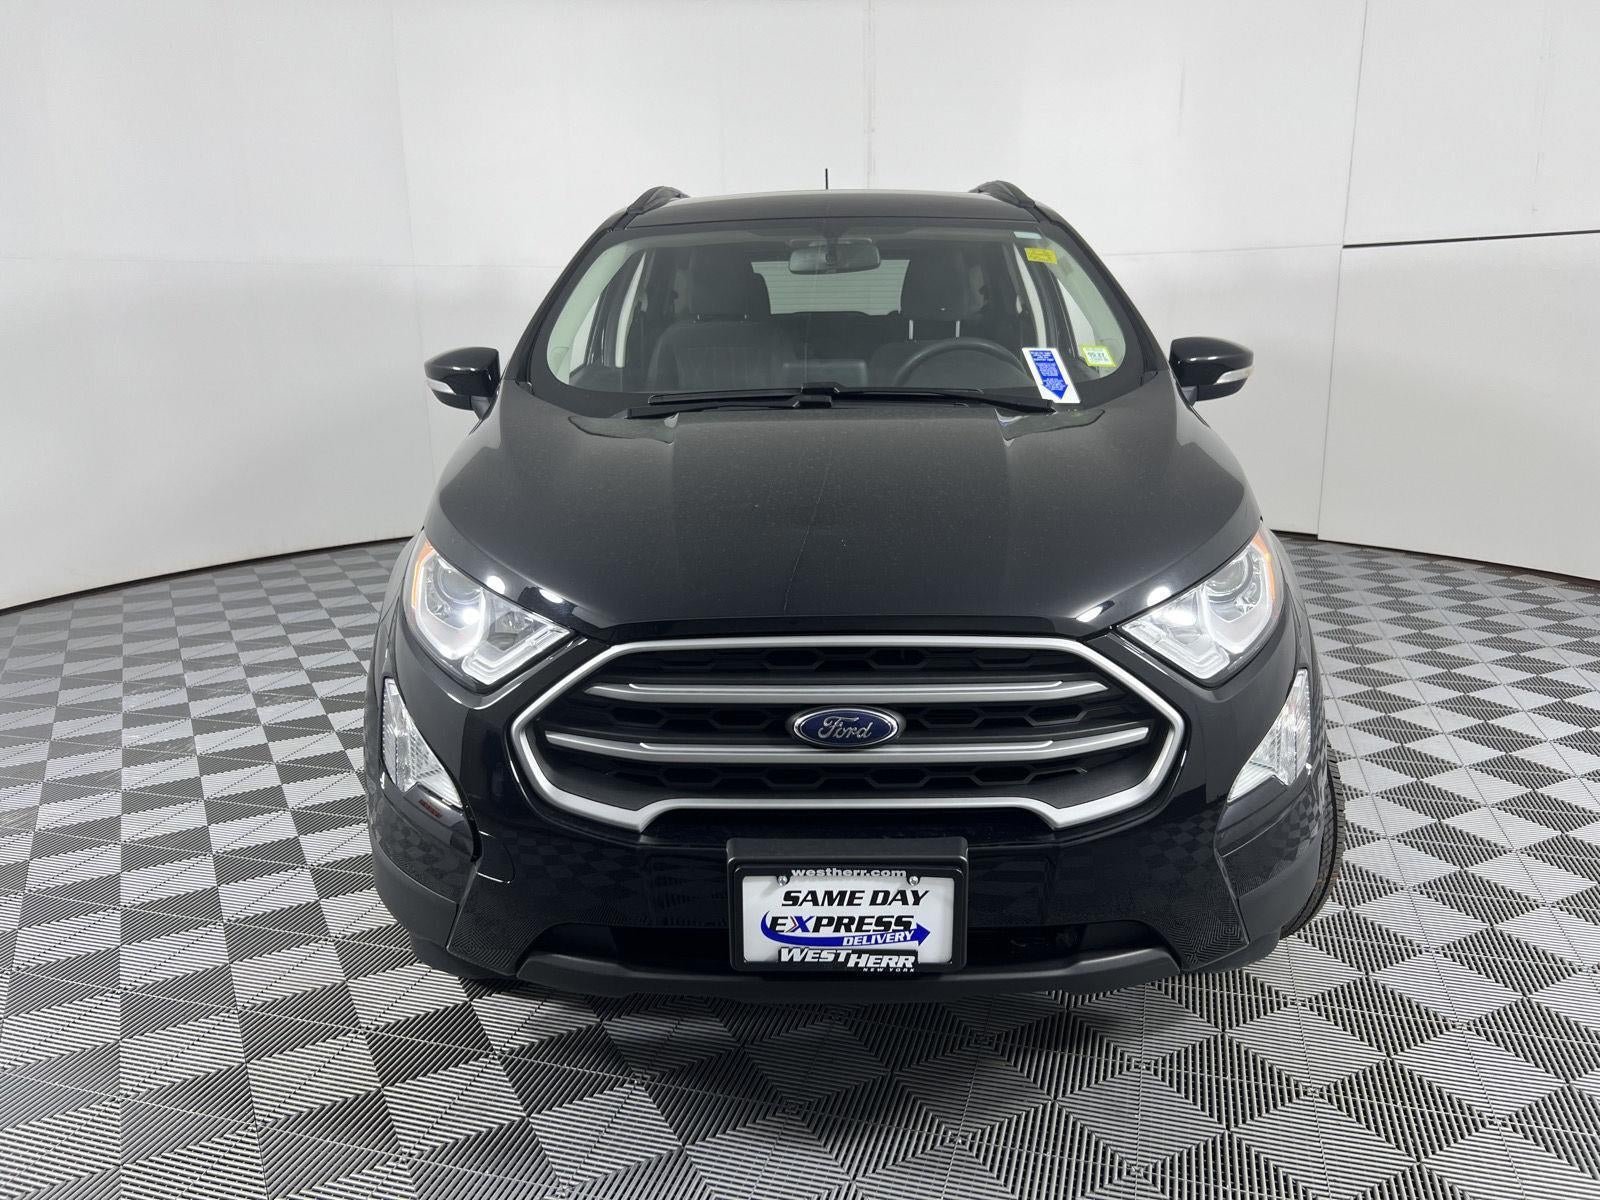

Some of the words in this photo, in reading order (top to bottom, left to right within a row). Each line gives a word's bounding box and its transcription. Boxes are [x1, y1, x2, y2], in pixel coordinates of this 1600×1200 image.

[817, 716, 873, 739] Ford
[791, 867, 907, 878] westherr.com
[782, 890, 865, 906] SAME
[870, 890, 929, 906] DAY
[769, 915, 914, 933] EXPRESS
[843, 930, 914, 946] DELIVERY
